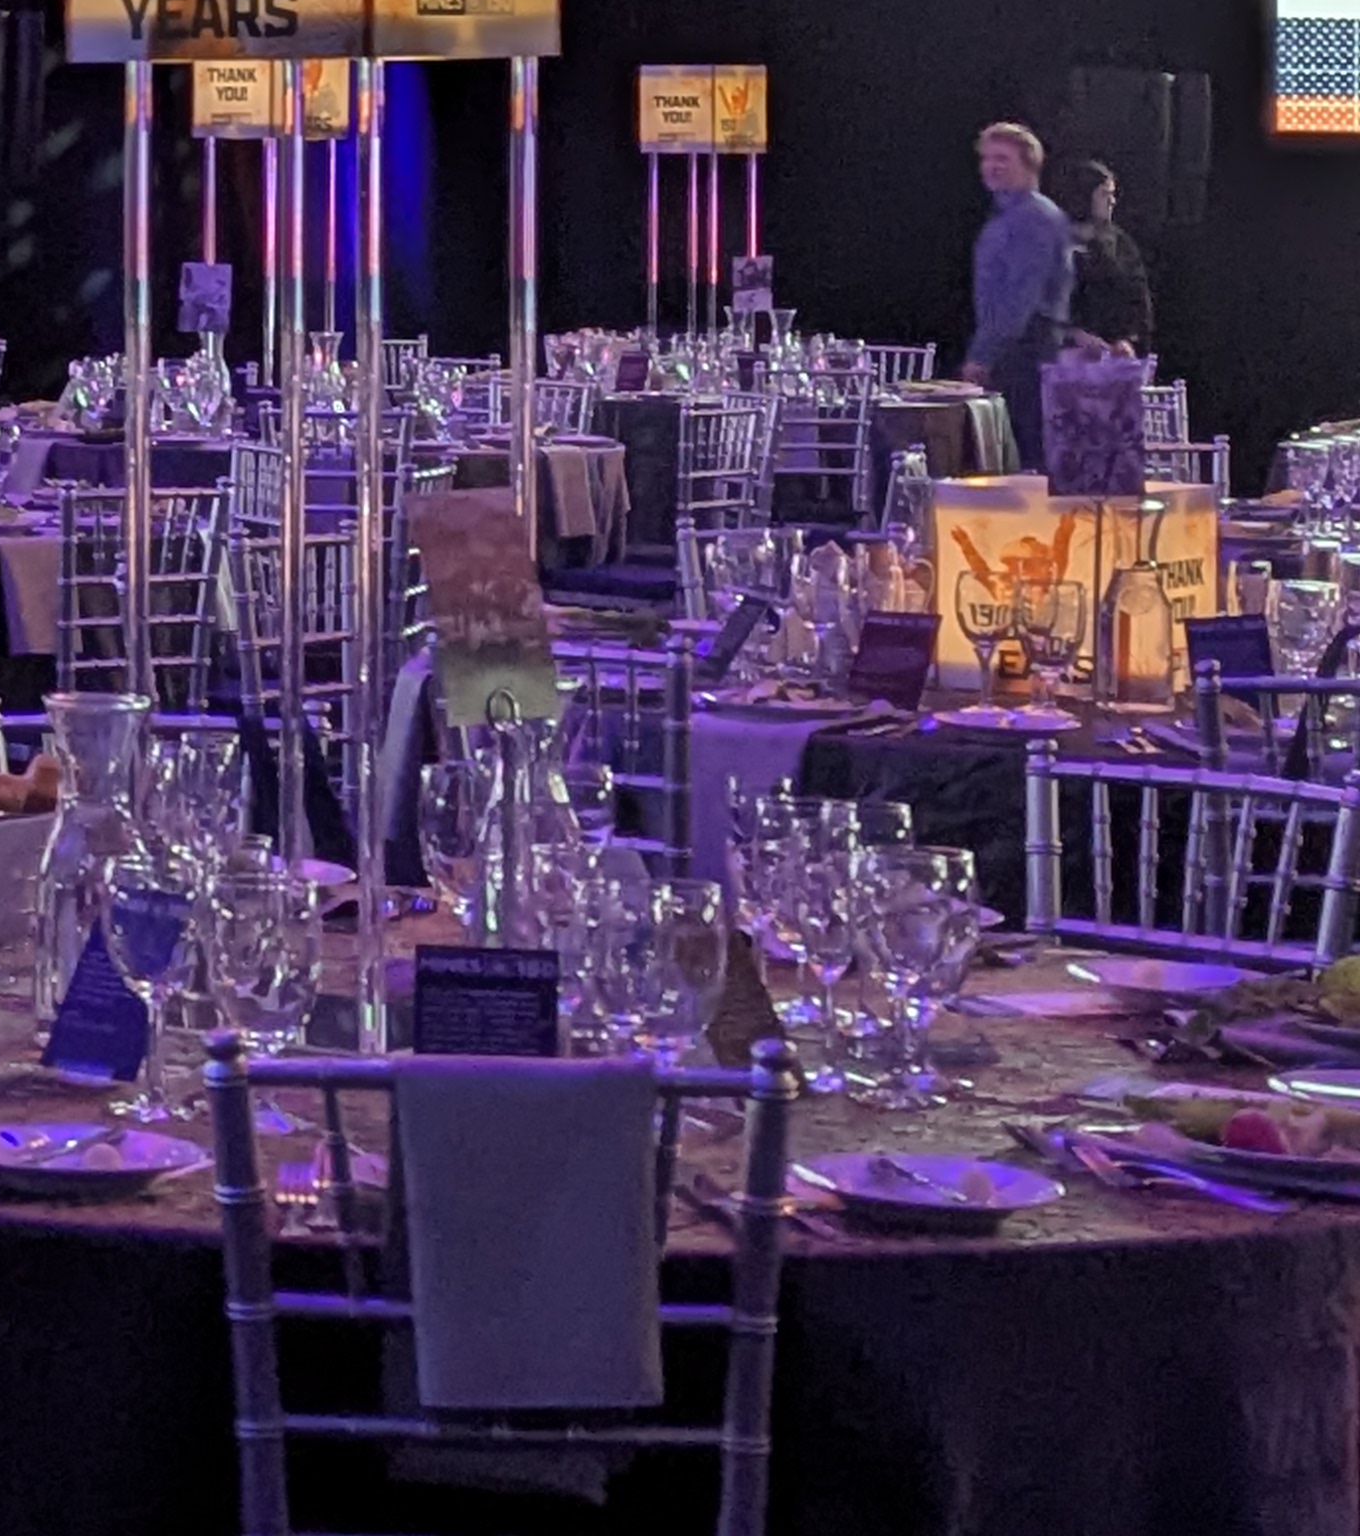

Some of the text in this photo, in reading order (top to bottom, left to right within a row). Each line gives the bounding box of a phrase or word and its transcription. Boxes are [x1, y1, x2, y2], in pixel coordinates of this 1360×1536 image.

[207, 68, 257, 83] THANK
[216, 86, 248, 102] YOU!
[653, 95, 700, 108] THANK
[662, 111, 692, 124] YOU!
